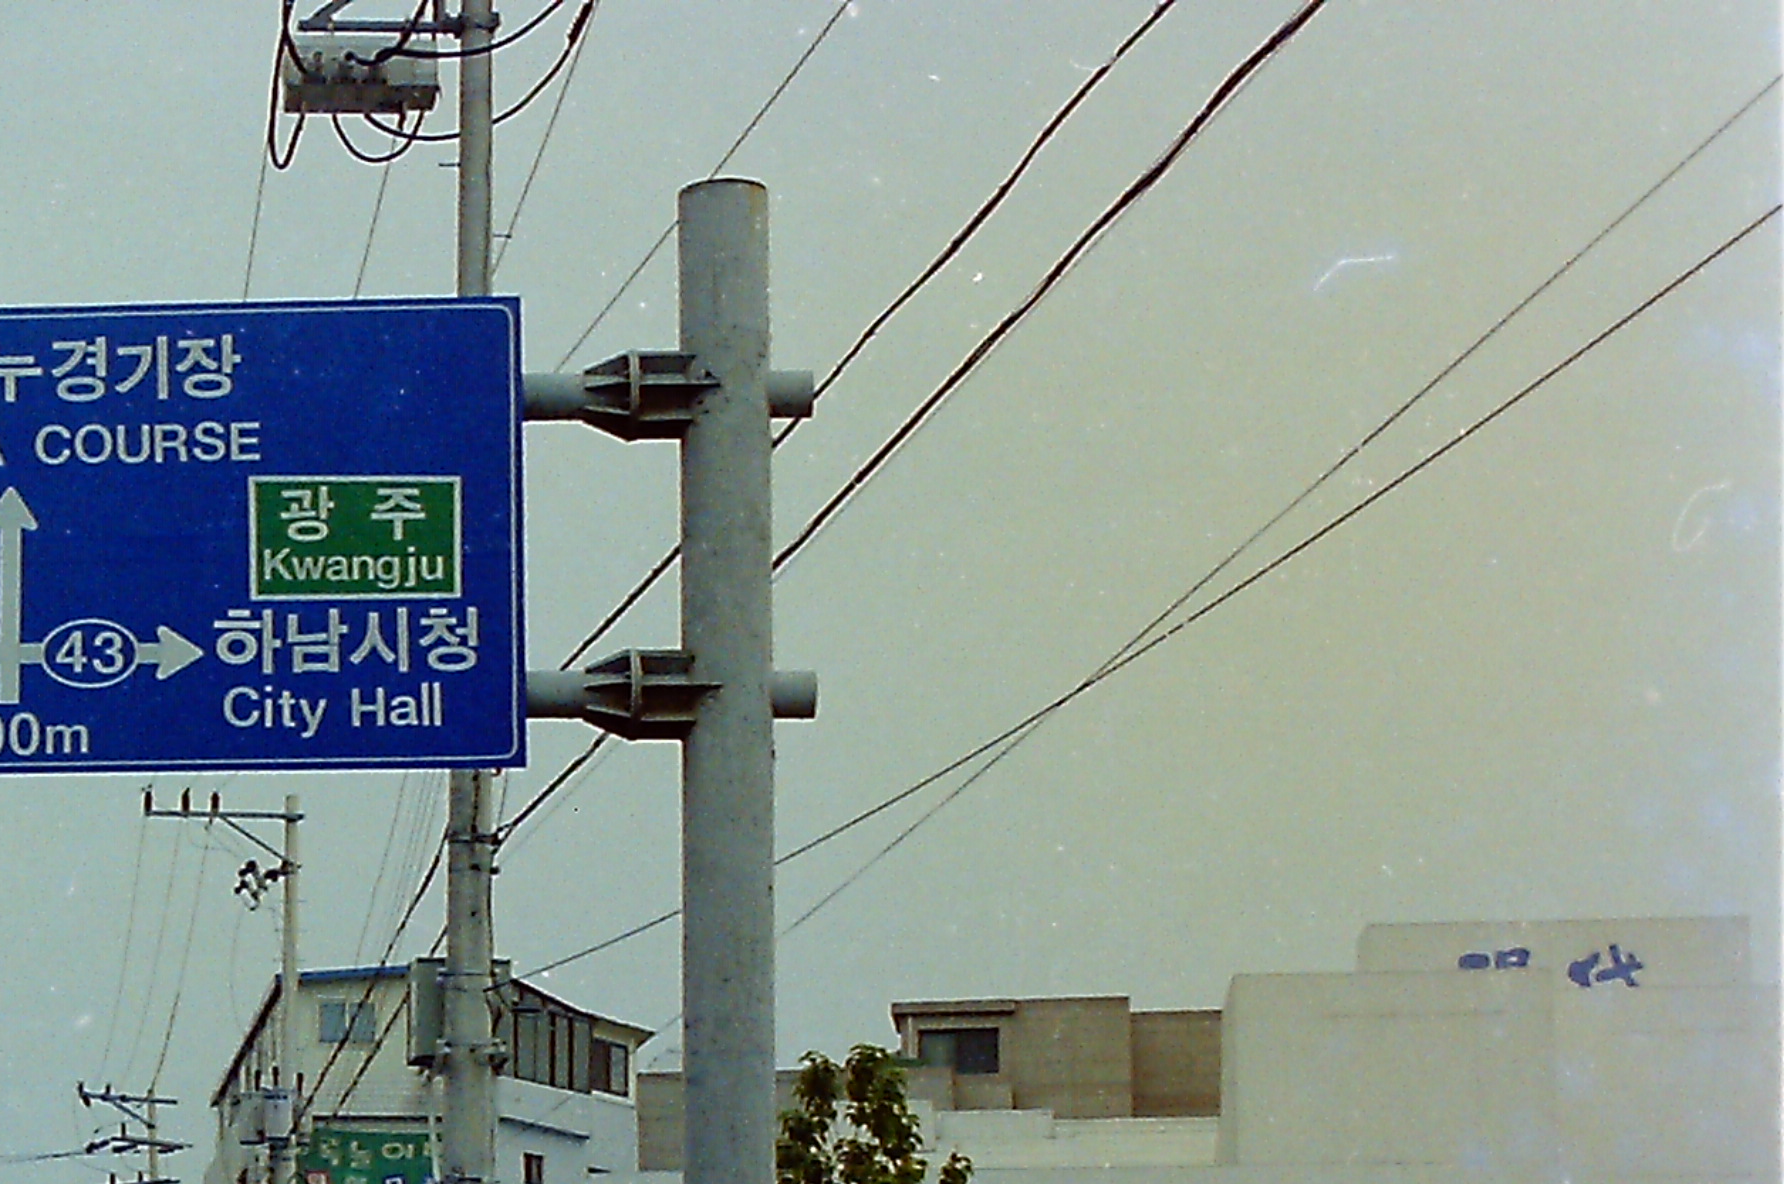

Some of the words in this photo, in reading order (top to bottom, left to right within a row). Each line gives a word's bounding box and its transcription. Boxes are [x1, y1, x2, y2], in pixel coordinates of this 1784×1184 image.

[34, 421, 263, 464] COURSE
[262, 548, 445, 591] Kwangju
[54, 631, 126, 675] 43
[214, 605, 479, 675] 하남시청
[223, 684, 325, 737] City
[351, 683, 445, 728] Hall
